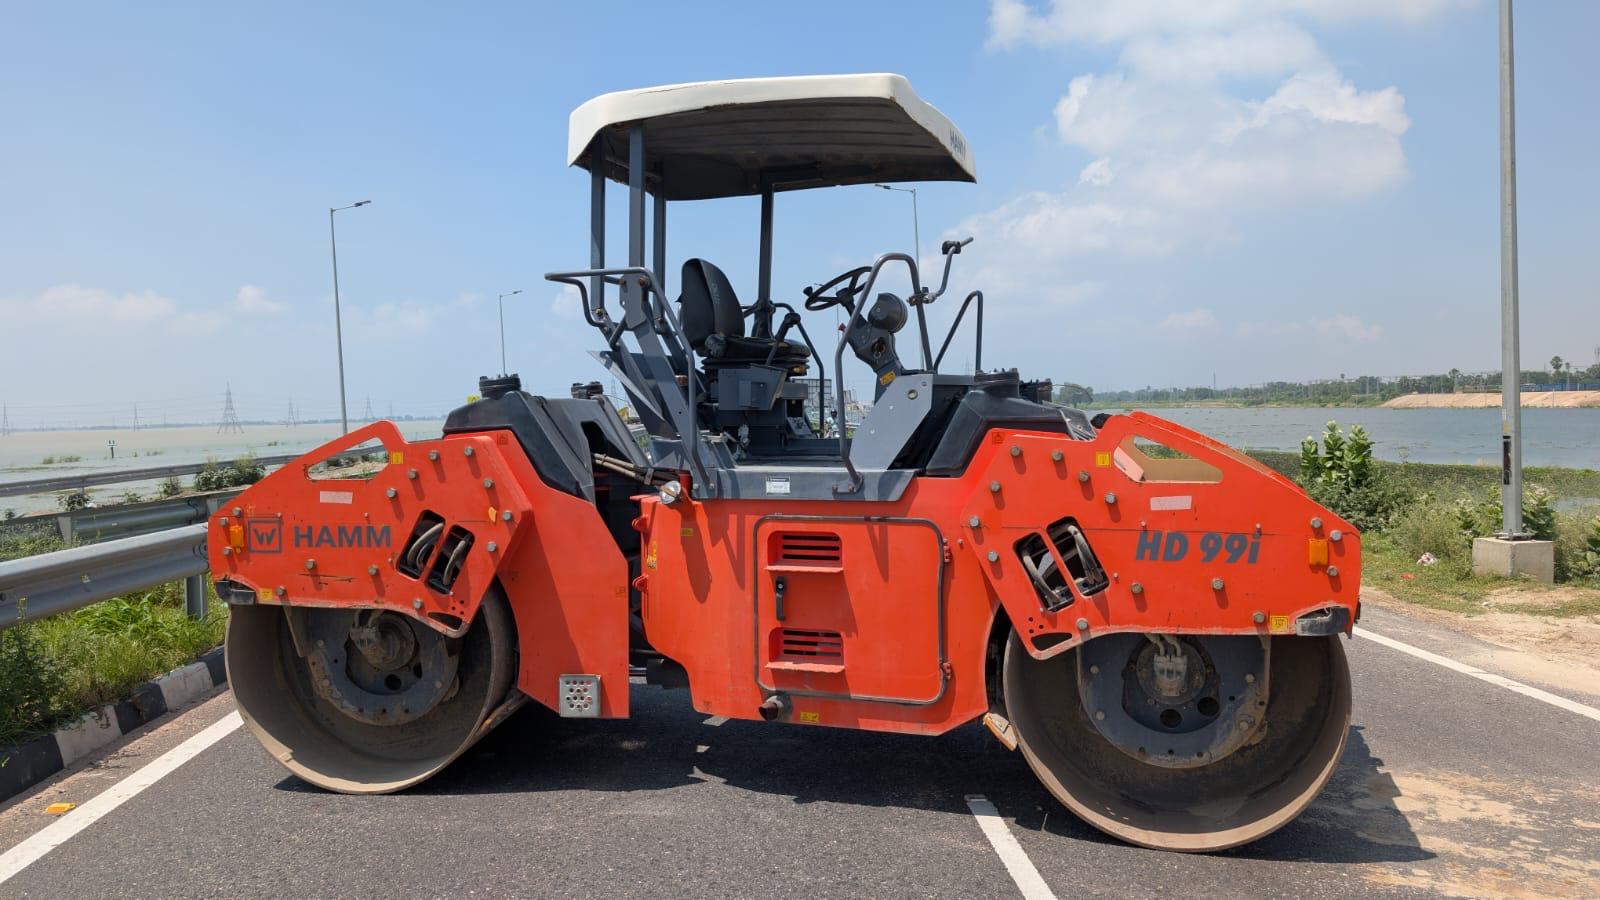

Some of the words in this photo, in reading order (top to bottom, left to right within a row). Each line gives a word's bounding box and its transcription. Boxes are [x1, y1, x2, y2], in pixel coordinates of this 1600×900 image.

[294, 526, 391, 548] HAMM
[1136, 531, 1188, 561] HD
[1200, 533, 1261, 564] 99i
